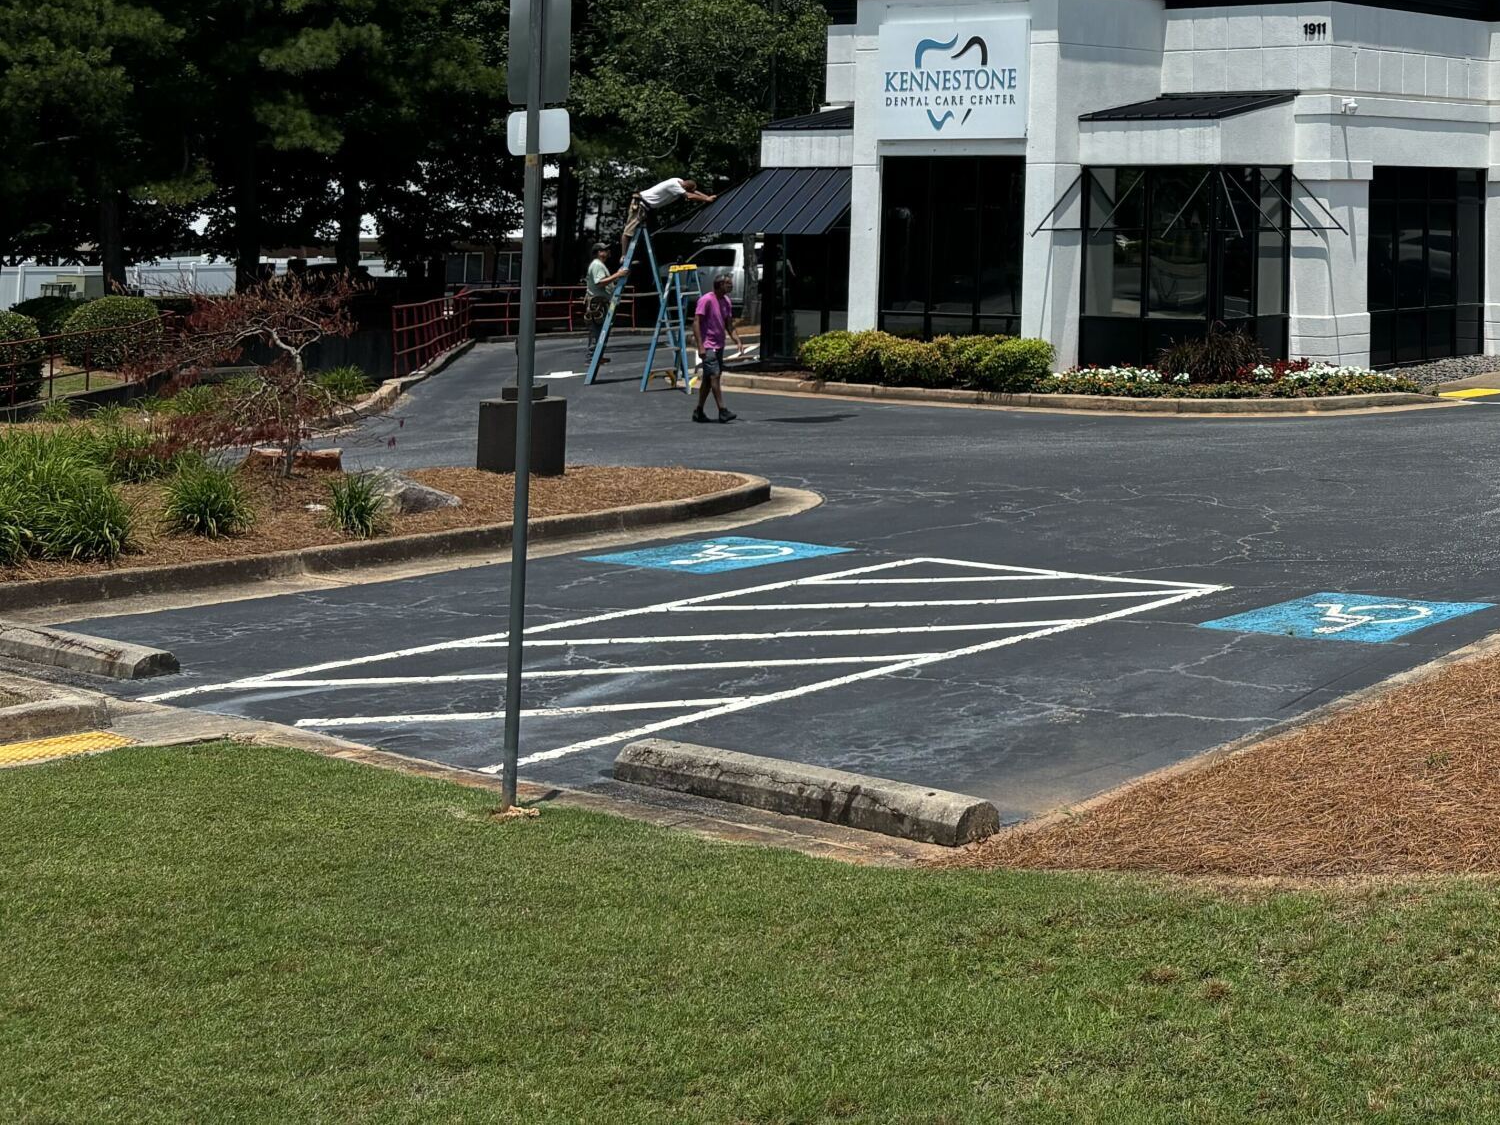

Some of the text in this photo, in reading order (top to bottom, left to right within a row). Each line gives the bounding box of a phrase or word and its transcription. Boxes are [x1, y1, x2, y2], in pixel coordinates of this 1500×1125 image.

[1303, 23, 1326, 35] 1911
[884, 68, 1017, 92] KENNESTONE
[885, 94, 1016, 107] DENTAL CARE CENTER
